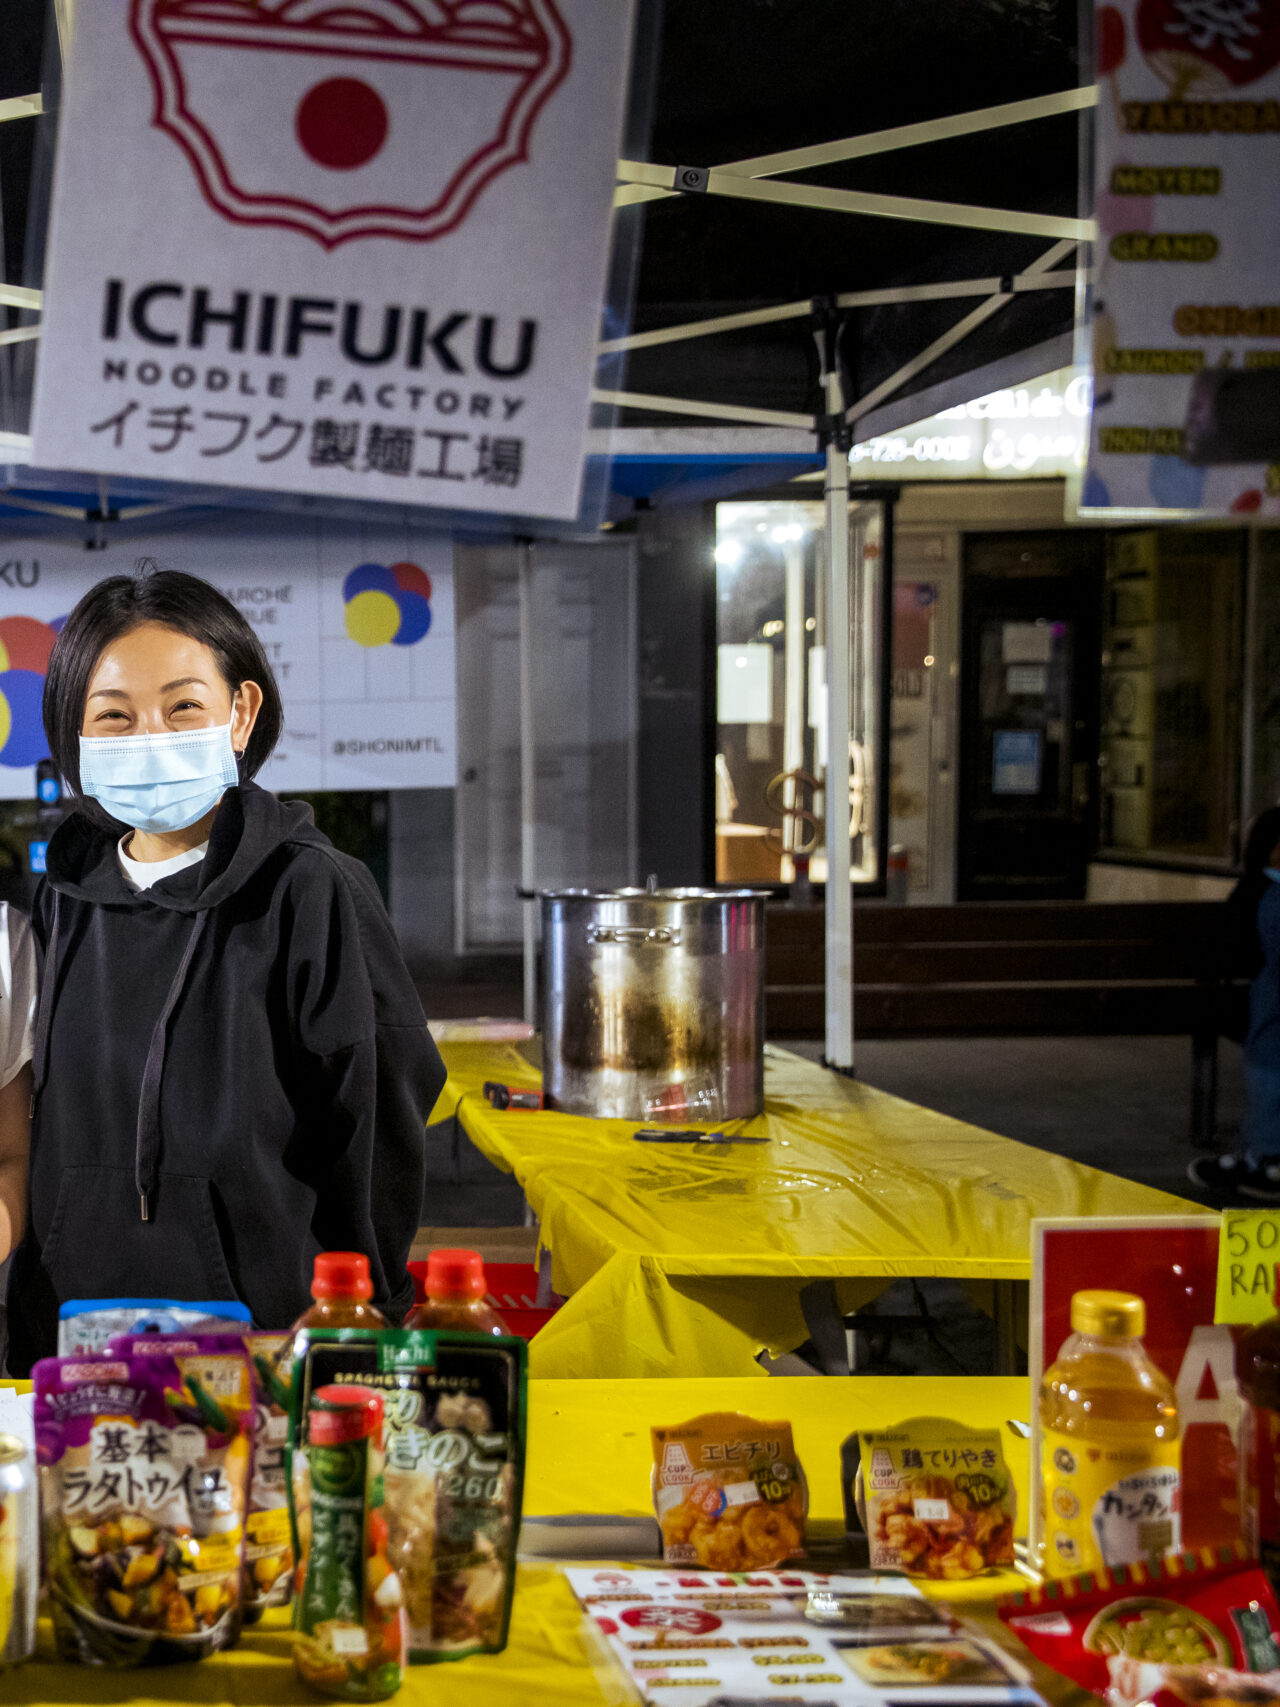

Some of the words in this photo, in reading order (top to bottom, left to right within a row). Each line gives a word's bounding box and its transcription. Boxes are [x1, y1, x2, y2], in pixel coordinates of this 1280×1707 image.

[1110, 233, 1218, 262] GRAND
[102, 279, 539, 380] ICHIFUKU
[103, 360, 288, 398] NOODLE
[314, 378, 524, 420] FACTORY
[91, 400, 524, 489] イチフク製麺工場
[221, 585, 293, 606] ARCHÉ
[333, 737, 445, 756] @SHONIMTL
[96, 1424, 197, 1464] 基本
[390, 1426, 506, 1471] きのこ
[702, 1441, 781, 1461] エビチリ
[667, 1464, 686, 1473] CUP
[902, 1448, 997, 1468] 鶏てりやき
[665, 1474, 690, 1482] COOK
[874, 1469, 893, 1477] CUP
